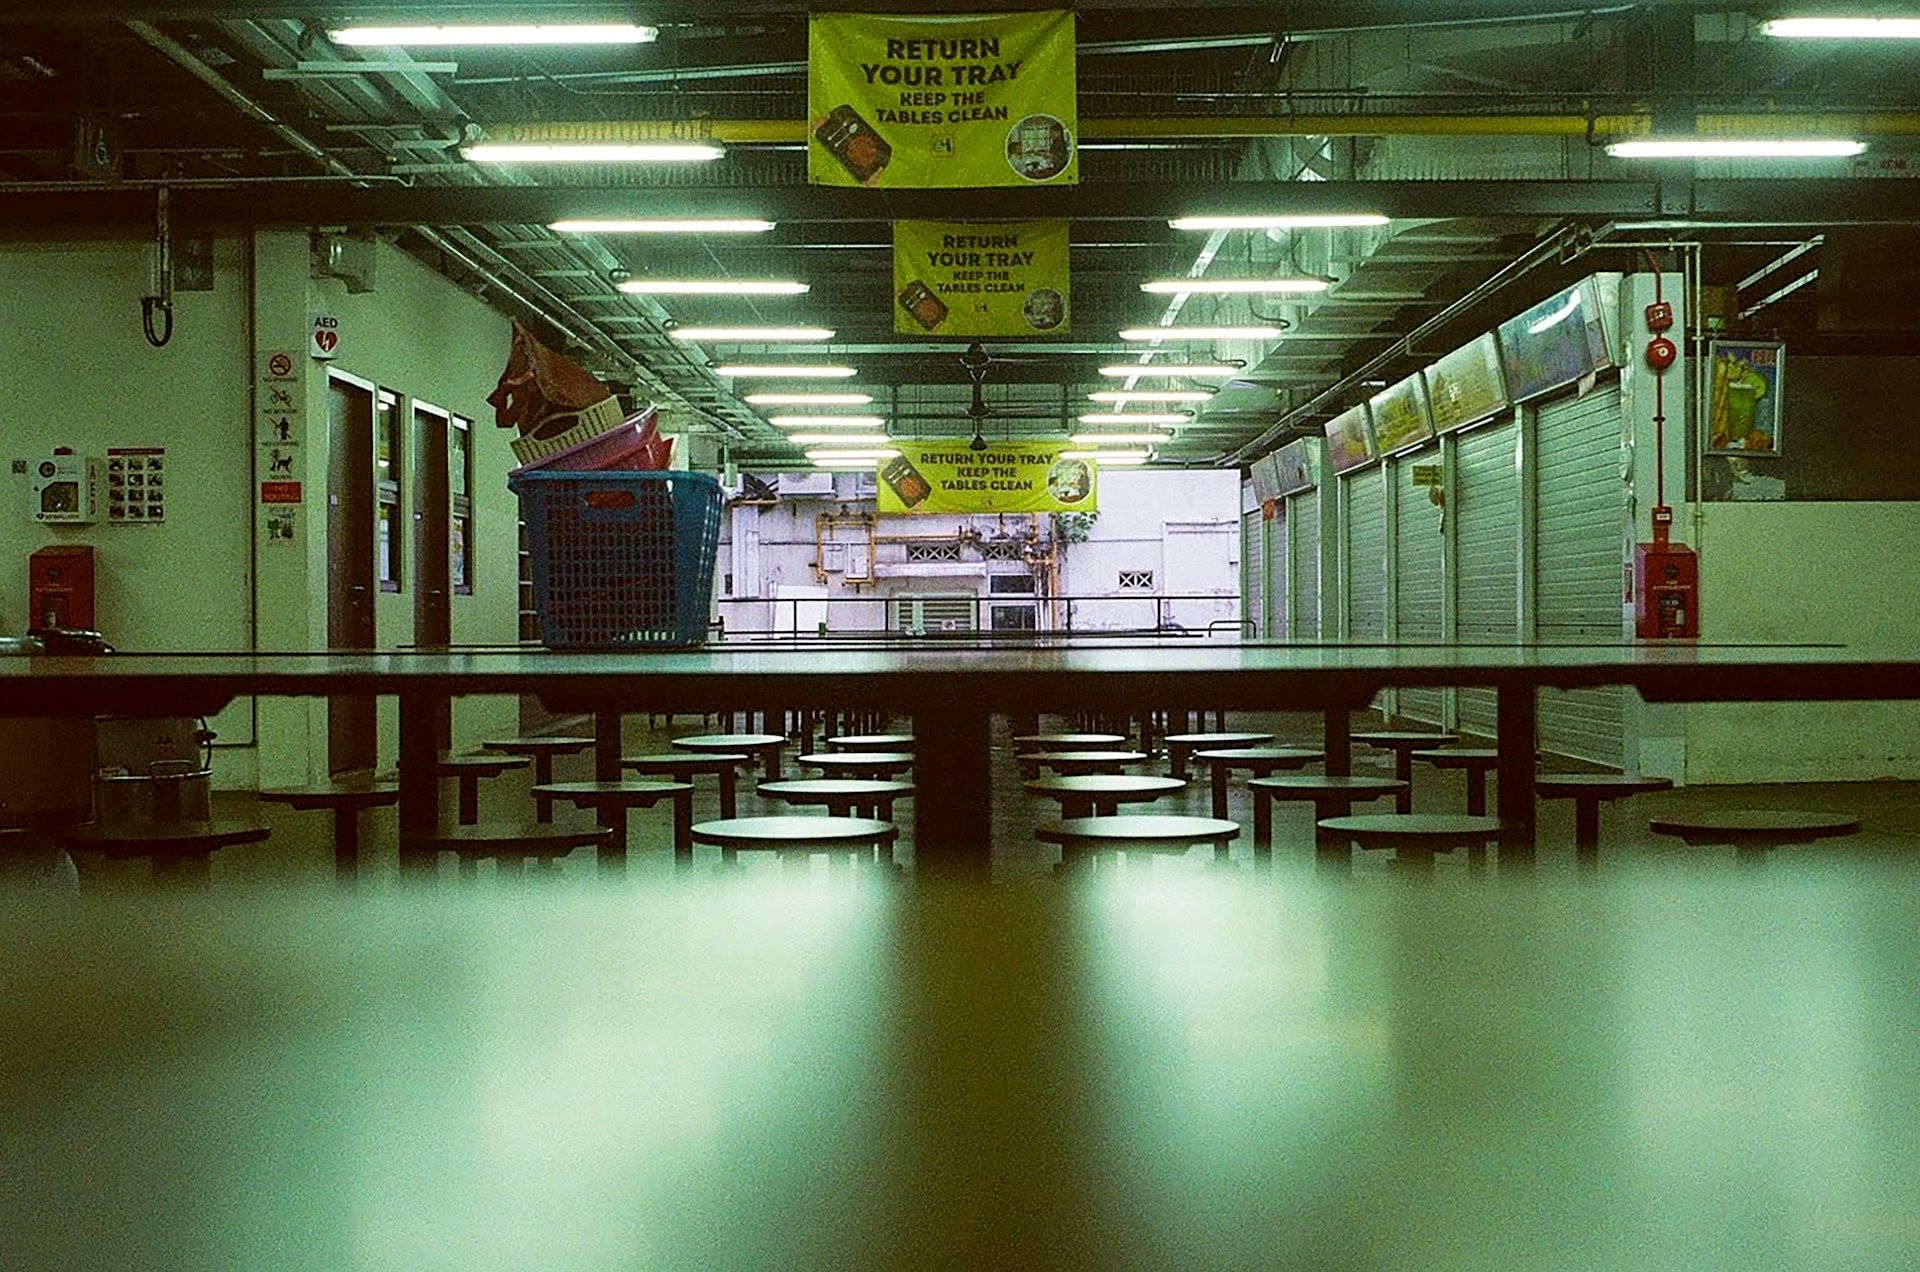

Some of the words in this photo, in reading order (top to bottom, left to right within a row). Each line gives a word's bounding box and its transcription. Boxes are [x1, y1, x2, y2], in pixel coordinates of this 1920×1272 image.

[887, 38, 1000, 60] RETURN
[860, 64, 943, 86] YOUR
[951, 61, 1023, 86] TRAY
[900, 92, 946, 107] KEEP
[951, 91, 985, 105] THE
[876, 108, 942, 124] TABLES
[947, 106, 1008, 122] CLEAN
[943, 235, 1017, 248] RETURN
[927, 252, 980, 267] YOUR
[985, 252, 1035, 267] TRAY
[953, 271, 983, 281] KEEP
[986, 271, 1009, 281] THE
[937, 283, 981, 293] TABLES
[984, 283, 1025, 293] CLEAN
[314, 317, 338, 328] AED
[920, 453, 973, 465] RETURN
[978, 453, 1016, 465] YOUR
[1019, 454, 1053, 465] TRAY
[957, 467, 989, 477] KEEP
[993, 467, 1017, 477] THE
[940, 480, 986, 491] TABLES
[990, 480, 1032, 491] CLEAN
